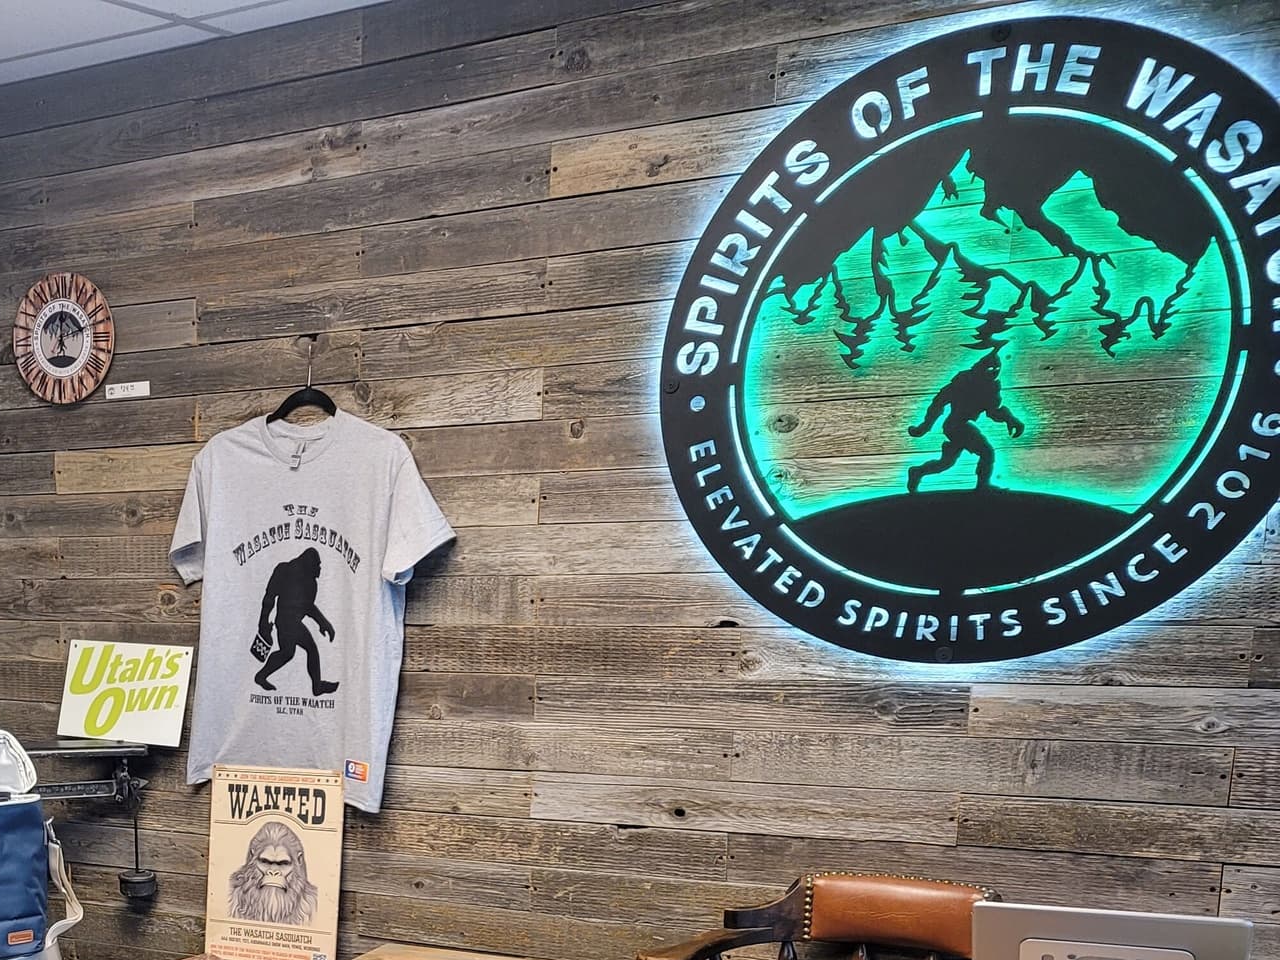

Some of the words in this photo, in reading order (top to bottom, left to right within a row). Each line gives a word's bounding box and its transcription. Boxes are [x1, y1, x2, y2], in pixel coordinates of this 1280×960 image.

[677, 138, 832, 377] SPIRITS
[851, 67, 931, 140] OF
[967, 42, 1102, 97] THE
[283, 503, 319, 518] THE
[688, 439, 825, 609] ELEVATED
[838, 598, 1022, 642] SPIRITS
[1043, 532, 1188, 626] SINCE
[1189, 411, 1280, 533] 2016
[232, 522, 291, 567] WASATCH
[294, 517, 362, 574] SASQUATCH
[69, 643, 184, 695] Utah's
[84, 685, 179, 737] Own
[273, 696, 283, 705] OF
[285, 697, 300, 706] THE
[228, 783, 326, 825] WANTED
[230, 927, 242, 937] THE
[244, 929, 274, 941] WASATCH
[275, 932, 312, 944] SASQUATCH
